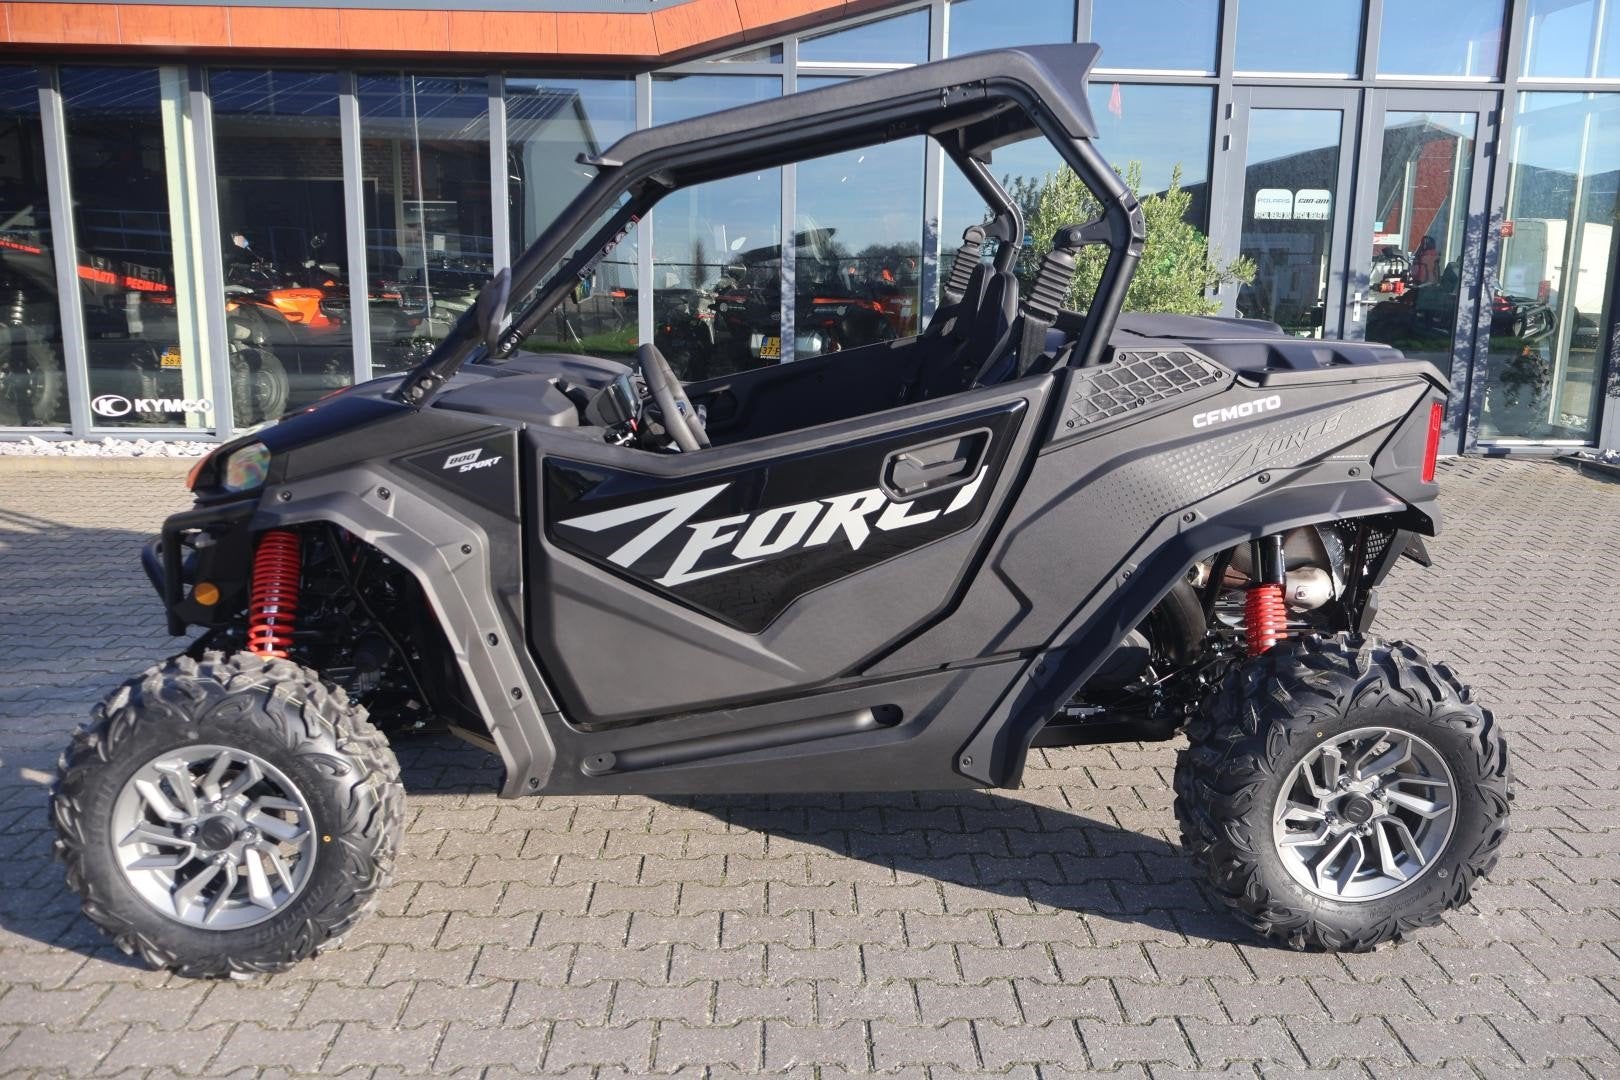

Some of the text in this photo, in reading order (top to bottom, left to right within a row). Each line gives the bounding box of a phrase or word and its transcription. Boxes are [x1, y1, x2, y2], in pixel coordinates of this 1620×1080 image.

[134, 398, 213, 413] KYMCO
[1193, 395, 1281, 428] CFMOTO
[459, 456, 502, 472] SPORT
